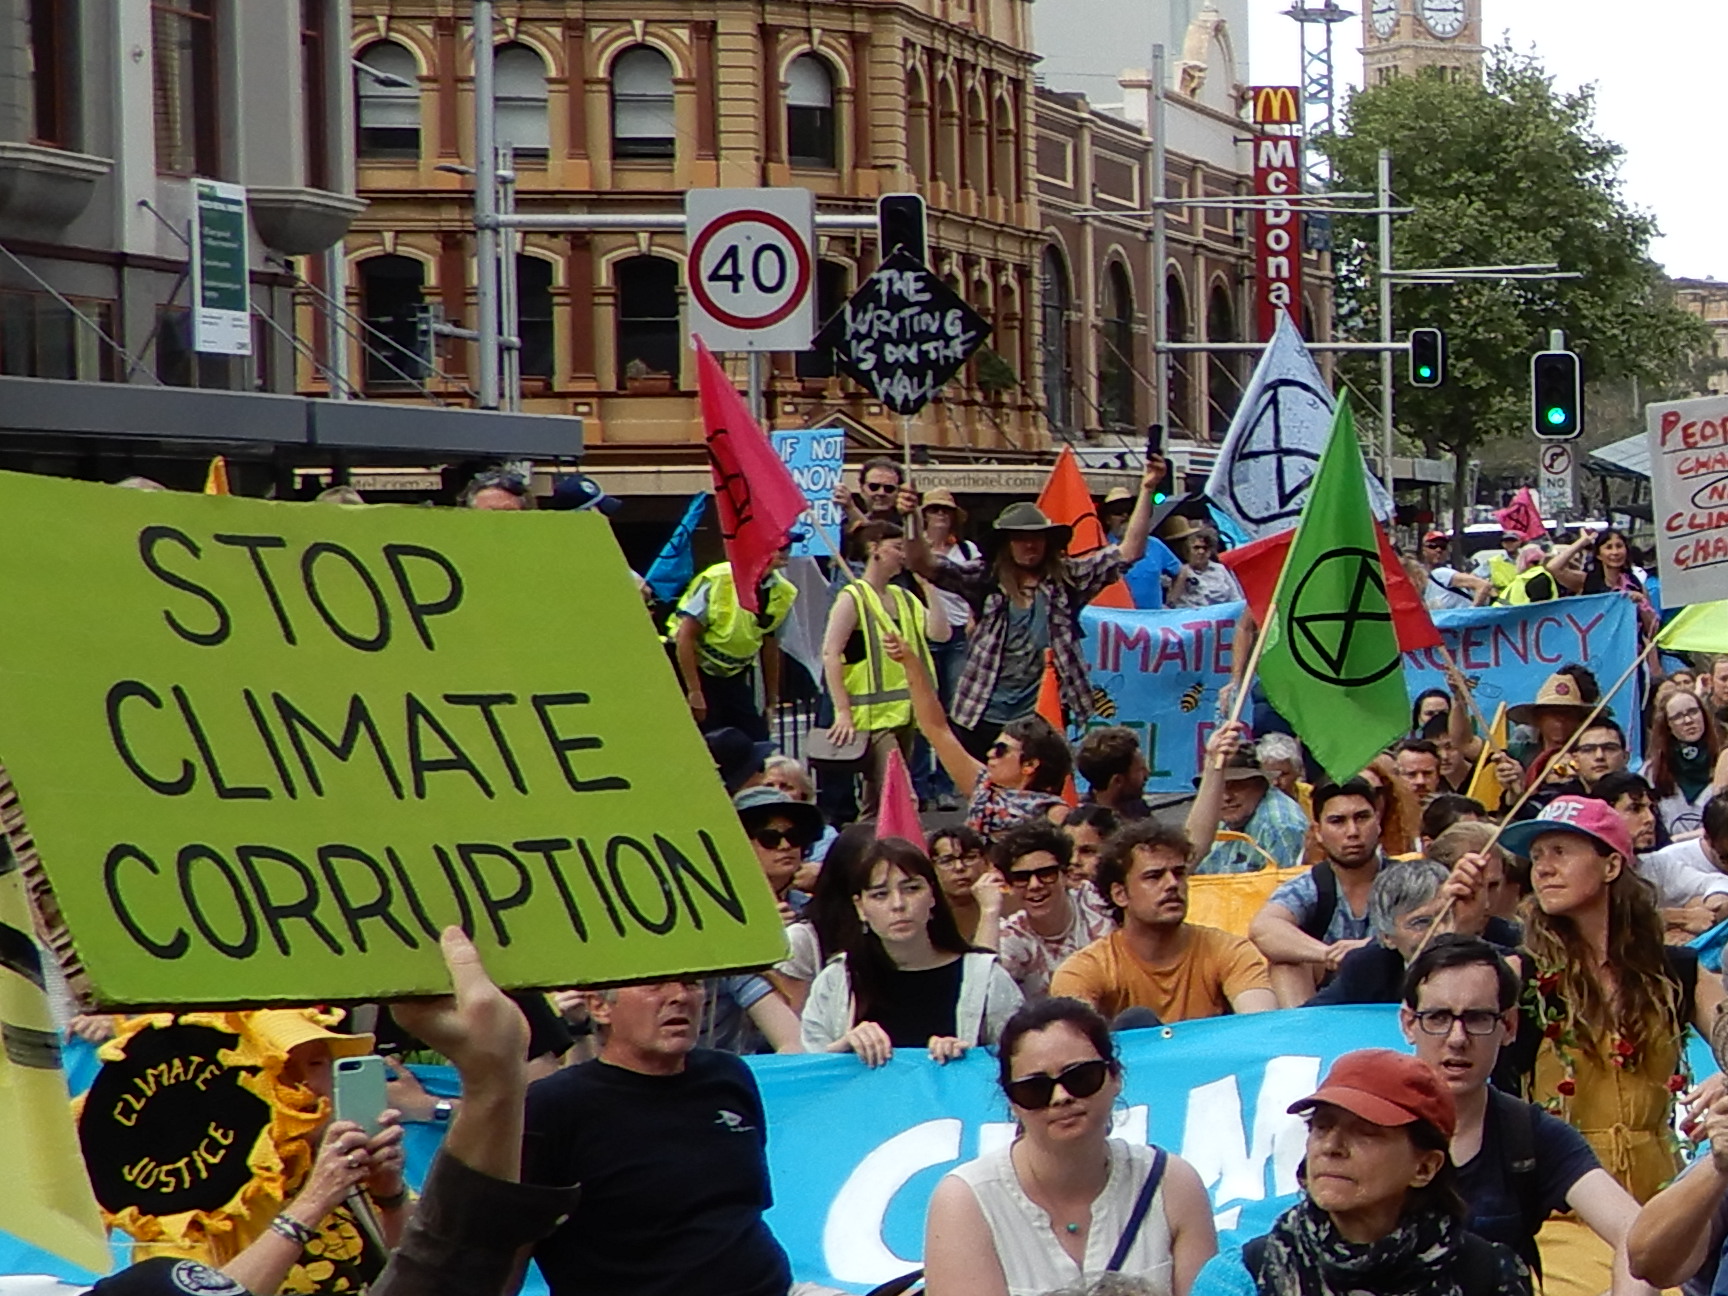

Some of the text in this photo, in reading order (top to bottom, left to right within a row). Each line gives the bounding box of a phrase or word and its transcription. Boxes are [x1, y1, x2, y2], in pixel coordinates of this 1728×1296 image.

[1258, 140, 1296, 332] McDonal
[707, 241, 789, 297] 40
[873, 269, 932, 303] THE
[843, 303, 967, 342] WRITING
[851, 330, 977, 371] IS ON THE
[870, 368, 942, 405] WALL
[780, 437, 843, 464] IF NOT
[794, 466, 843, 493] NOW
[1546, 477, 1566, 489] NO
[801, 527, 815, 554] ?
[138, 524, 465, 652] STOP
[1096, 617, 1237, 674] IMATE
[104, 679, 631, 802] CLIMATE
[103, 828, 749, 961] CORRUPTION
[113, 1055, 221, 1127] CLIMATE
[121, 1121, 235, 1195] JUSTICE
